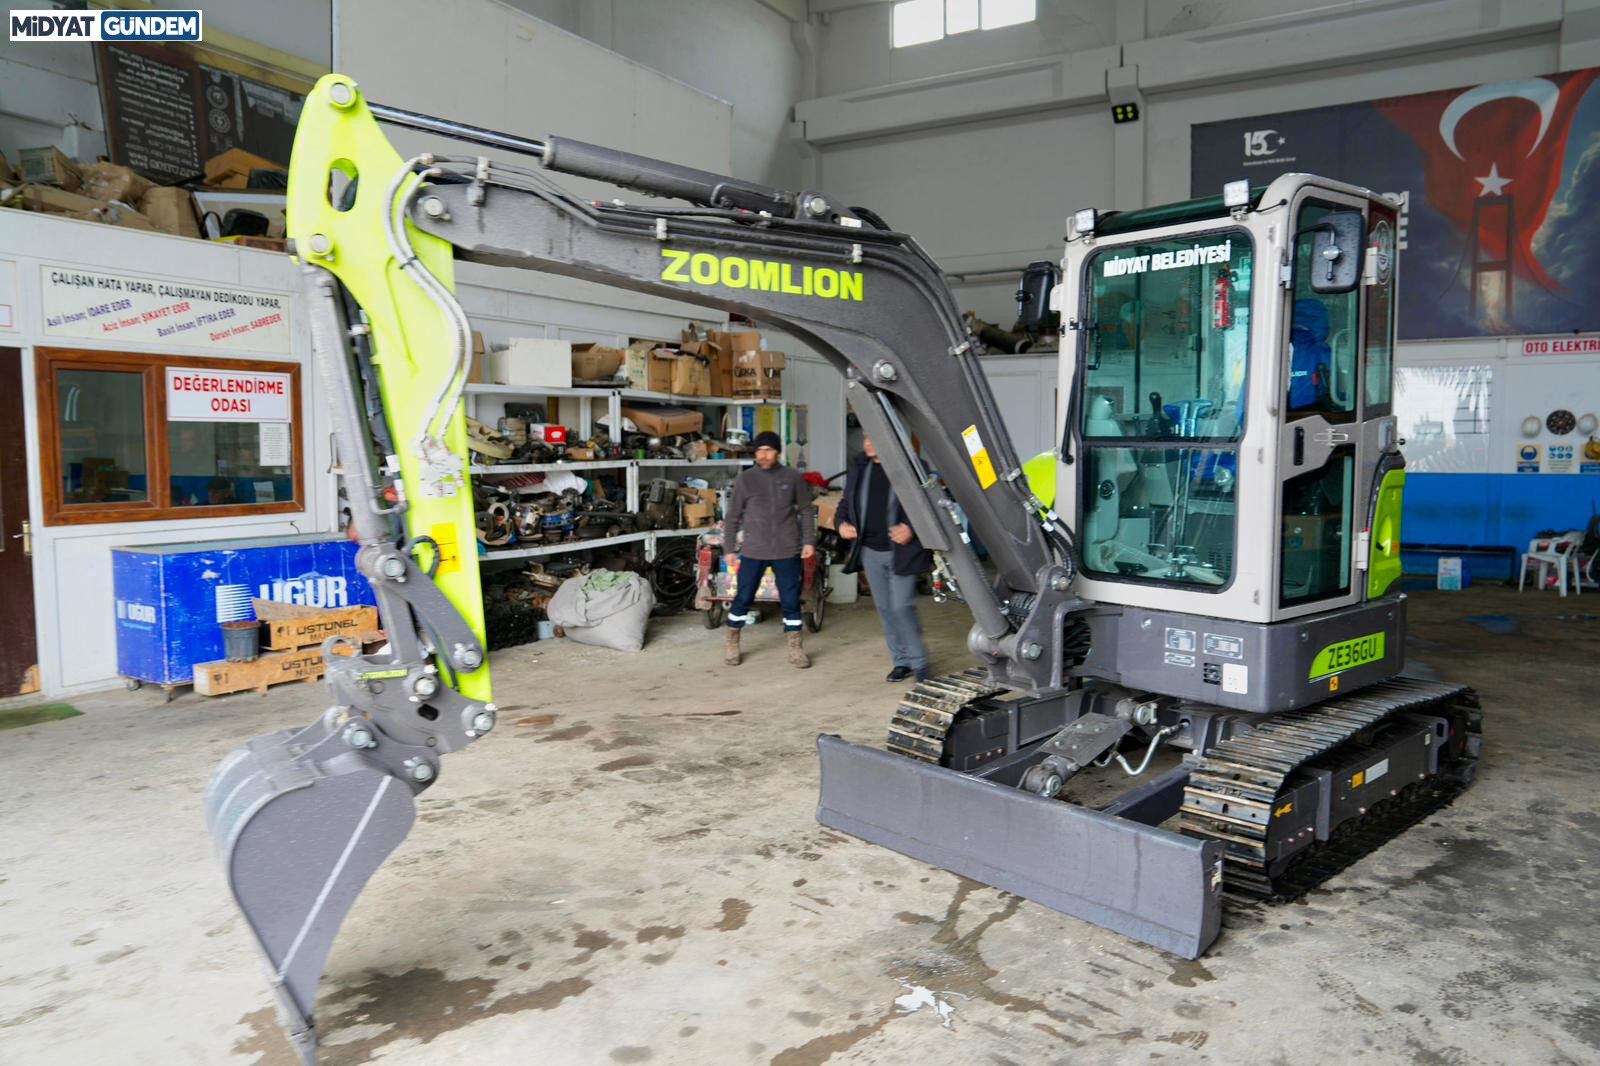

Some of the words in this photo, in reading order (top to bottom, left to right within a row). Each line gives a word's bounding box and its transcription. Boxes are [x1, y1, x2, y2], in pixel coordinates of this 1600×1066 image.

[1103, 255, 1150, 277] MİDYAT
[1151, 239, 1231, 271] BELEDİYESİ
[661, 249, 863, 301] ZOOMLION
[51, 272, 94, 288] ÇALIŞAN
[97, 278, 122, 291] HATA
[159, 285, 211, 300] ÇALIŞMAYAN
[213, 291, 254, 306] DEDİKODU
[111, 298, 132, 312] EDER
[171, 301, 192, 314] EDER
[218, 308, 237, 320] EDER
[1525, 341, 1548, 353] OTO
[173, 374, 284, 395] DEĞERLENDİRME
[210, 398, 251, 412] ODASI
[1328, 637, 1377, 670] ZE36GU
